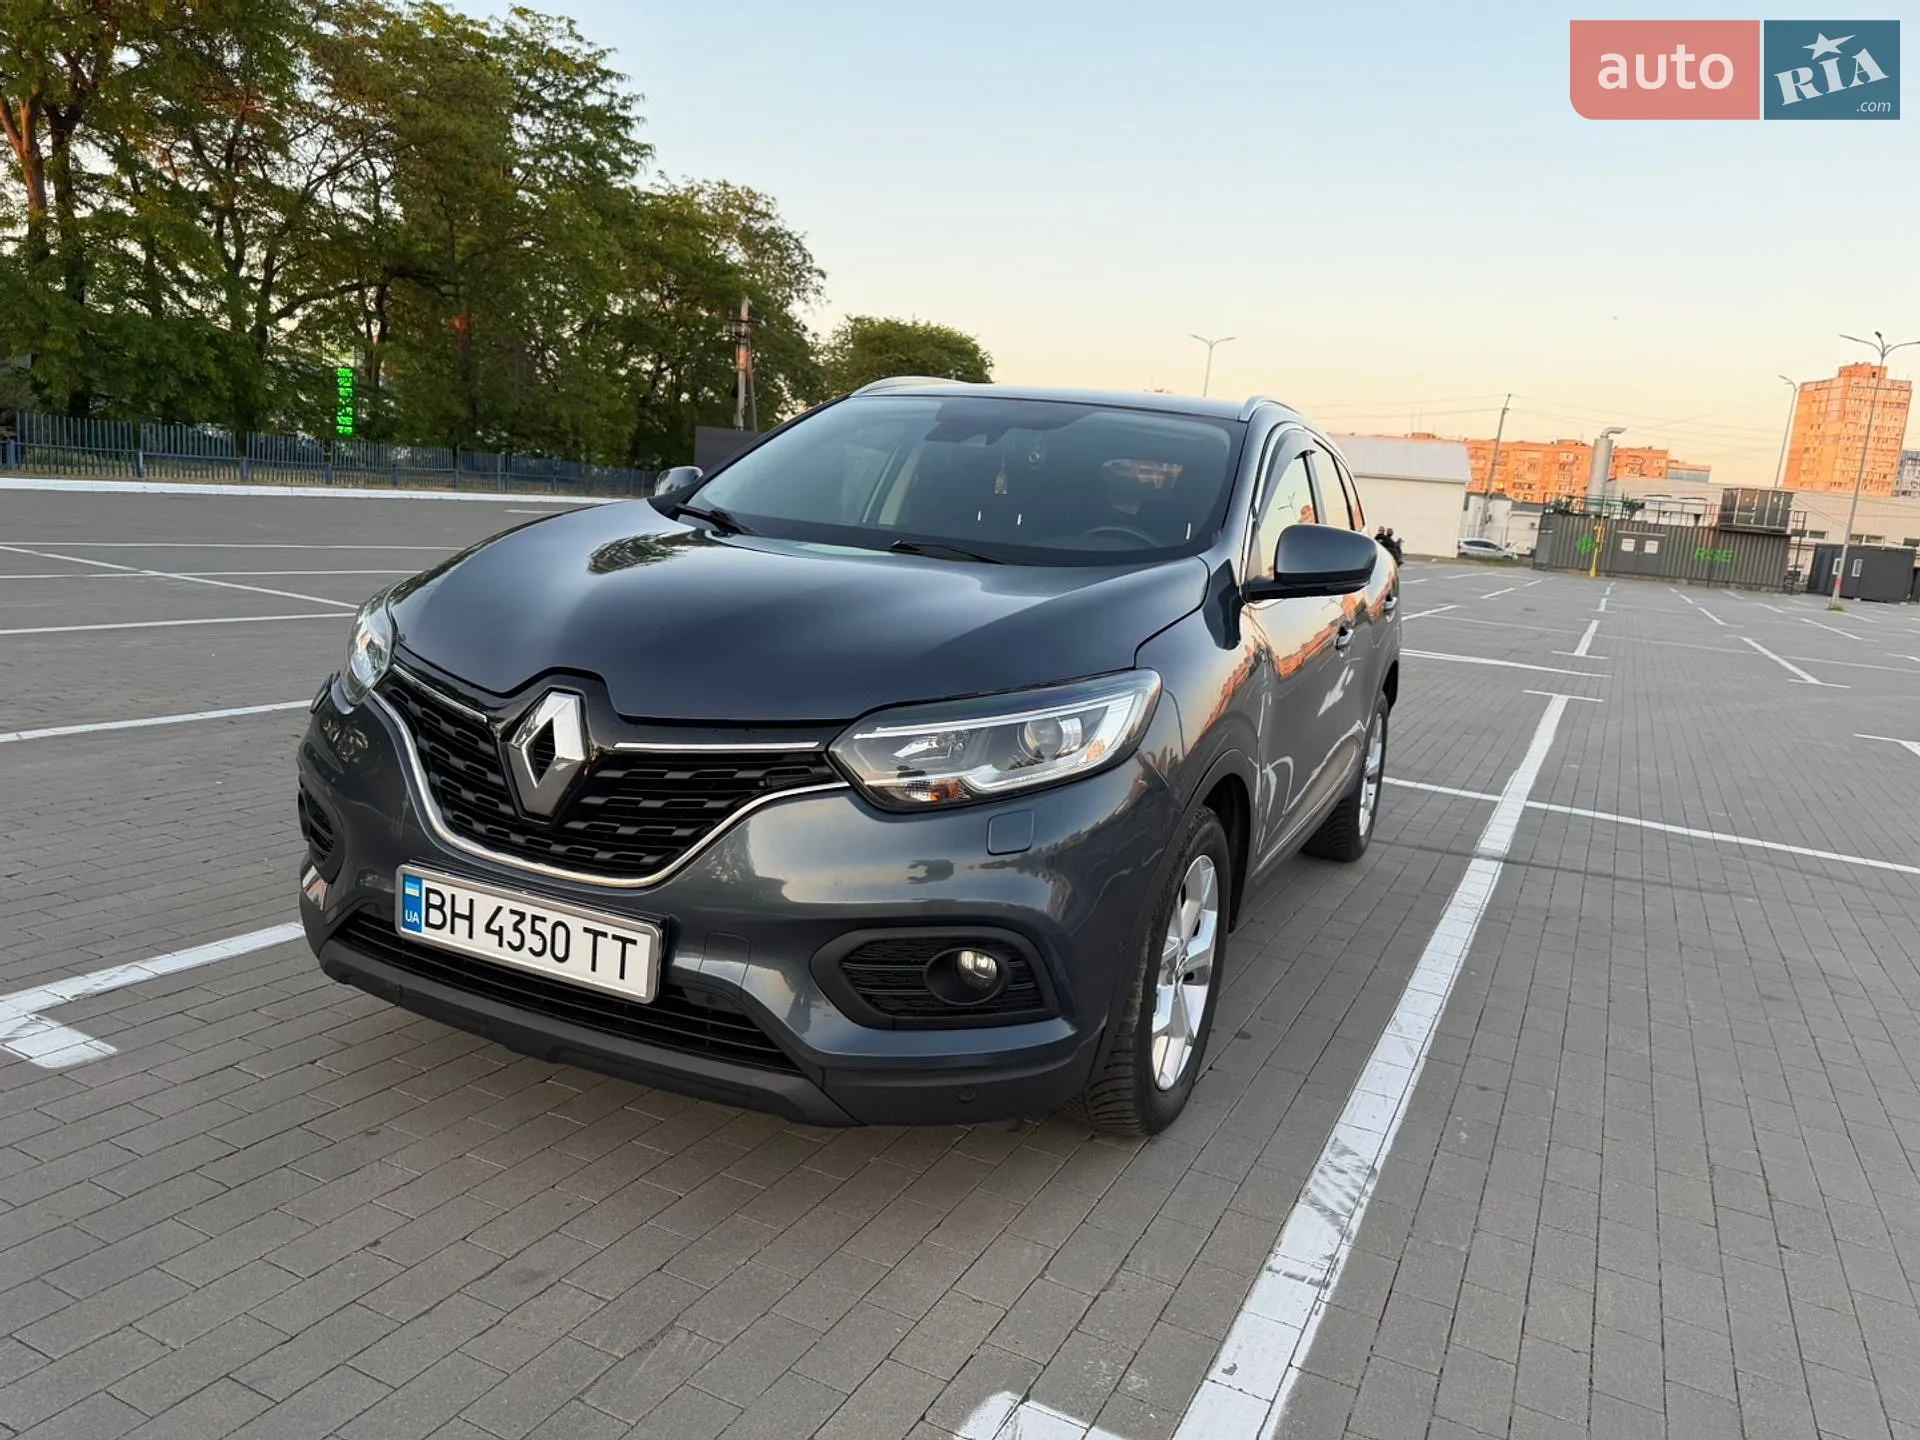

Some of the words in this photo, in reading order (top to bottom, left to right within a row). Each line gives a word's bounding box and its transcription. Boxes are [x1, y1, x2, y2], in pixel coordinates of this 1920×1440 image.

[404, 910, 420, 925] UA
[425, 887, 475, 939] BH
[485, 906, 571, 963] 4350
[583, 927, 637, 980] TT
